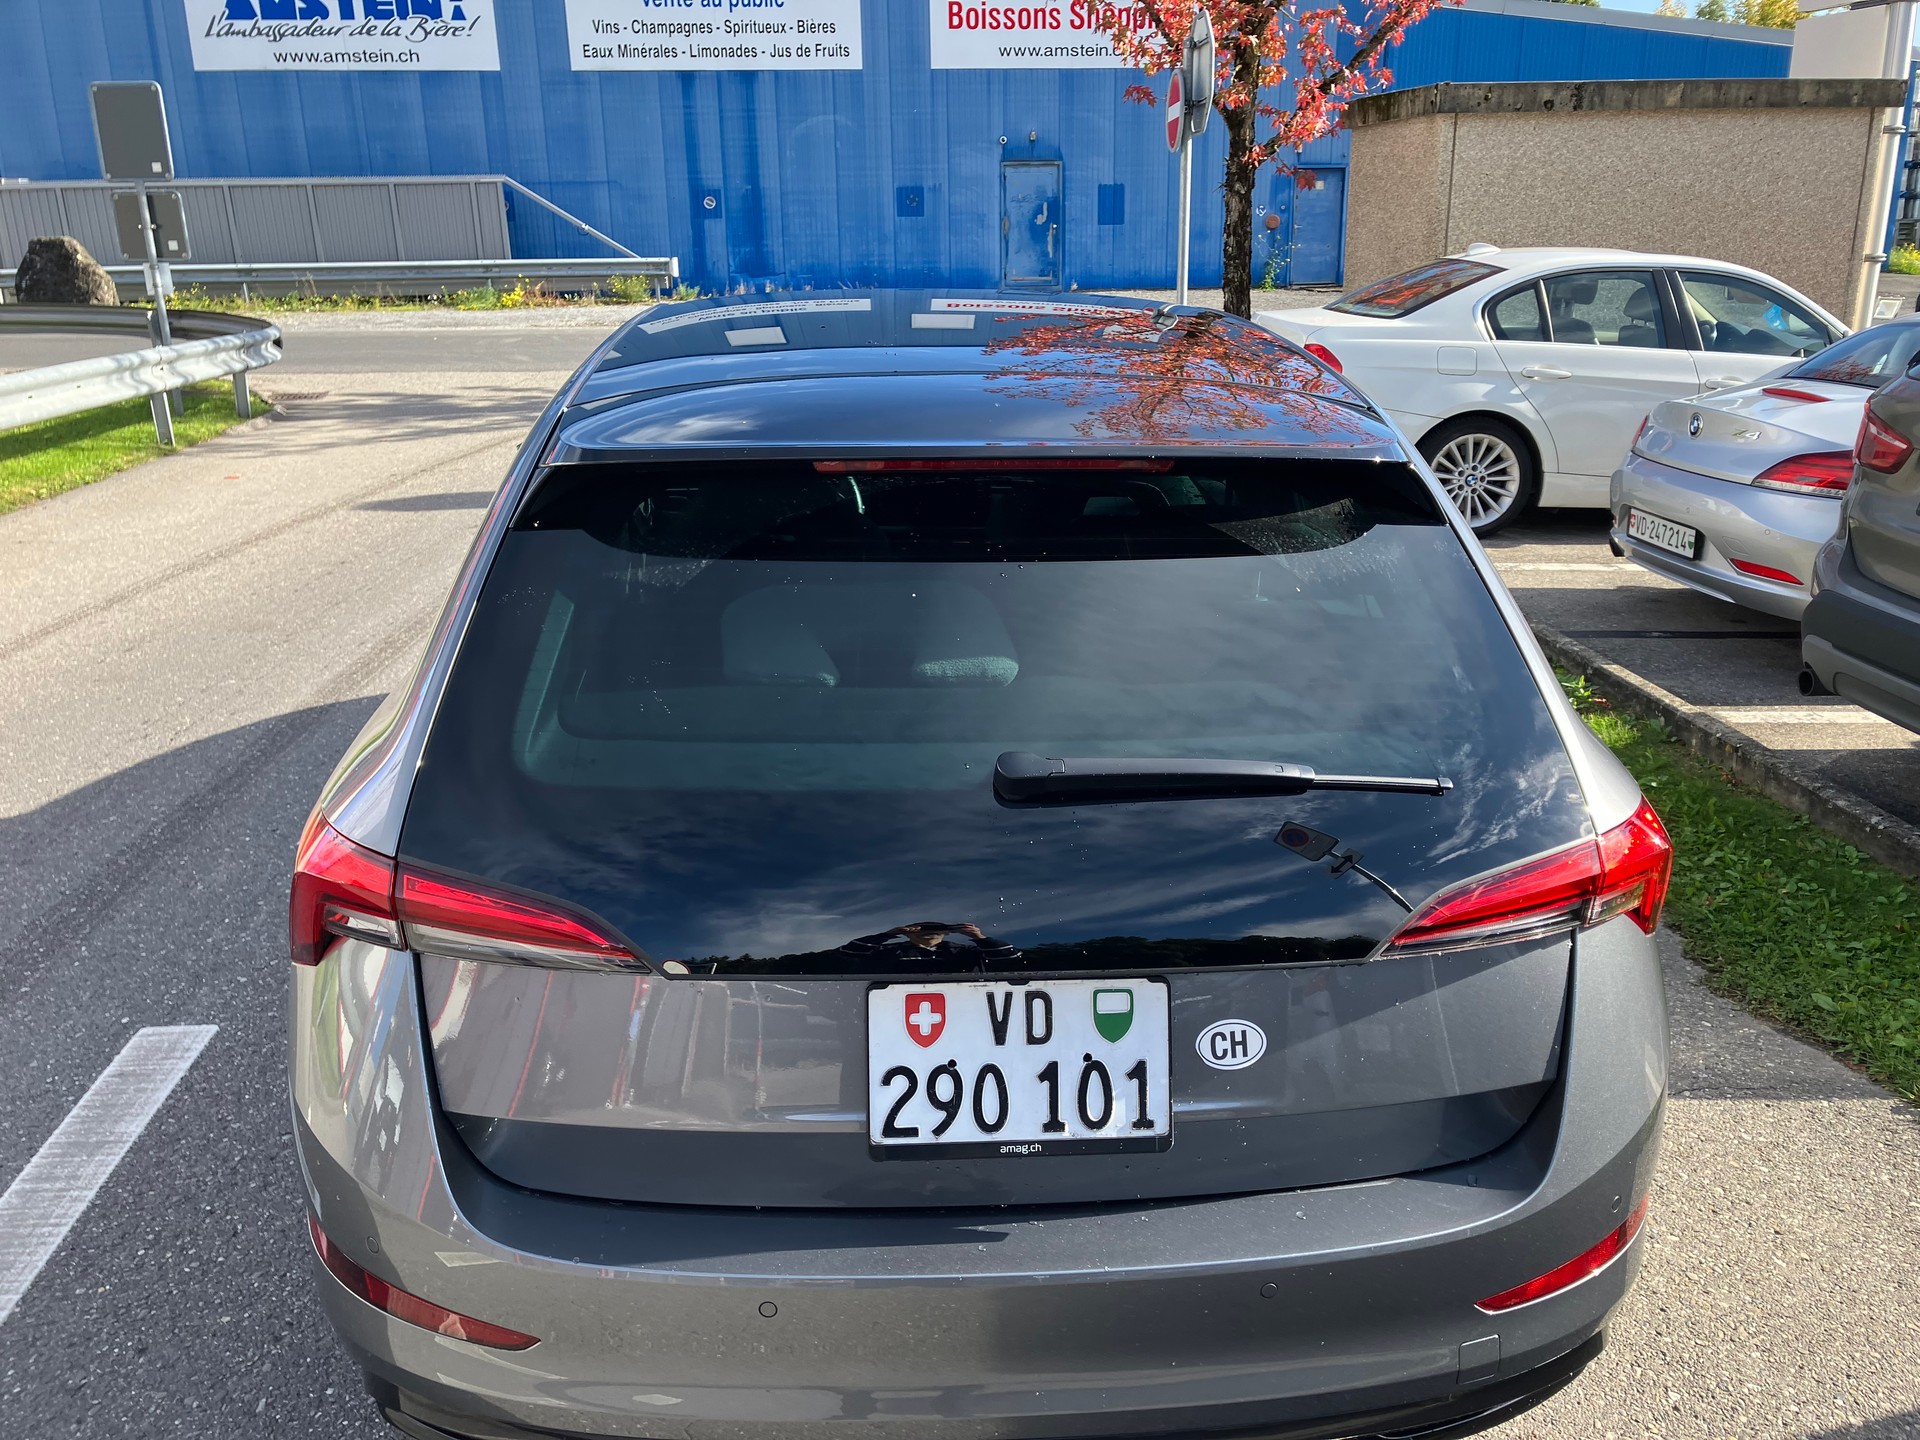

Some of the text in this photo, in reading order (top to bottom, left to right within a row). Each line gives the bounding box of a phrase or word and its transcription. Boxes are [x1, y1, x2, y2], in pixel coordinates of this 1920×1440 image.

[700, 0, 722, 8] au
[948, 0, 1061, 30] Boissons
[349, 16, 377, 37] de
[380, 16, 402, 37] la
[405, 15, 481, 43] Bière!
[592, 19, 620, 34] Vins
[631, 19, 713, 38] Champagnes
[724, 19, 787, 38] Spiritueux
[797, 18, 836, 34] Bières
[273, 48, 420, 63] www.amstein.ch
[582, 43, 614, 59] Eaux
[617, 43, 678, 59] Minérales
[689, 43, 758, 58] Limonades
[770, 43, 792, 58] Jus
[796, 43, 811, 58] de
[815, 42, 850, 58] Fruits
[998, 43, 1123, 57] www.amstein.c
[985, 990, 1053, 1047] VD
[1209, 1029, 1249, 1061] CH
[880, 1058, 1155, 1139] 290 101
[1000, 1143, 1042, 1156] amag.ch
